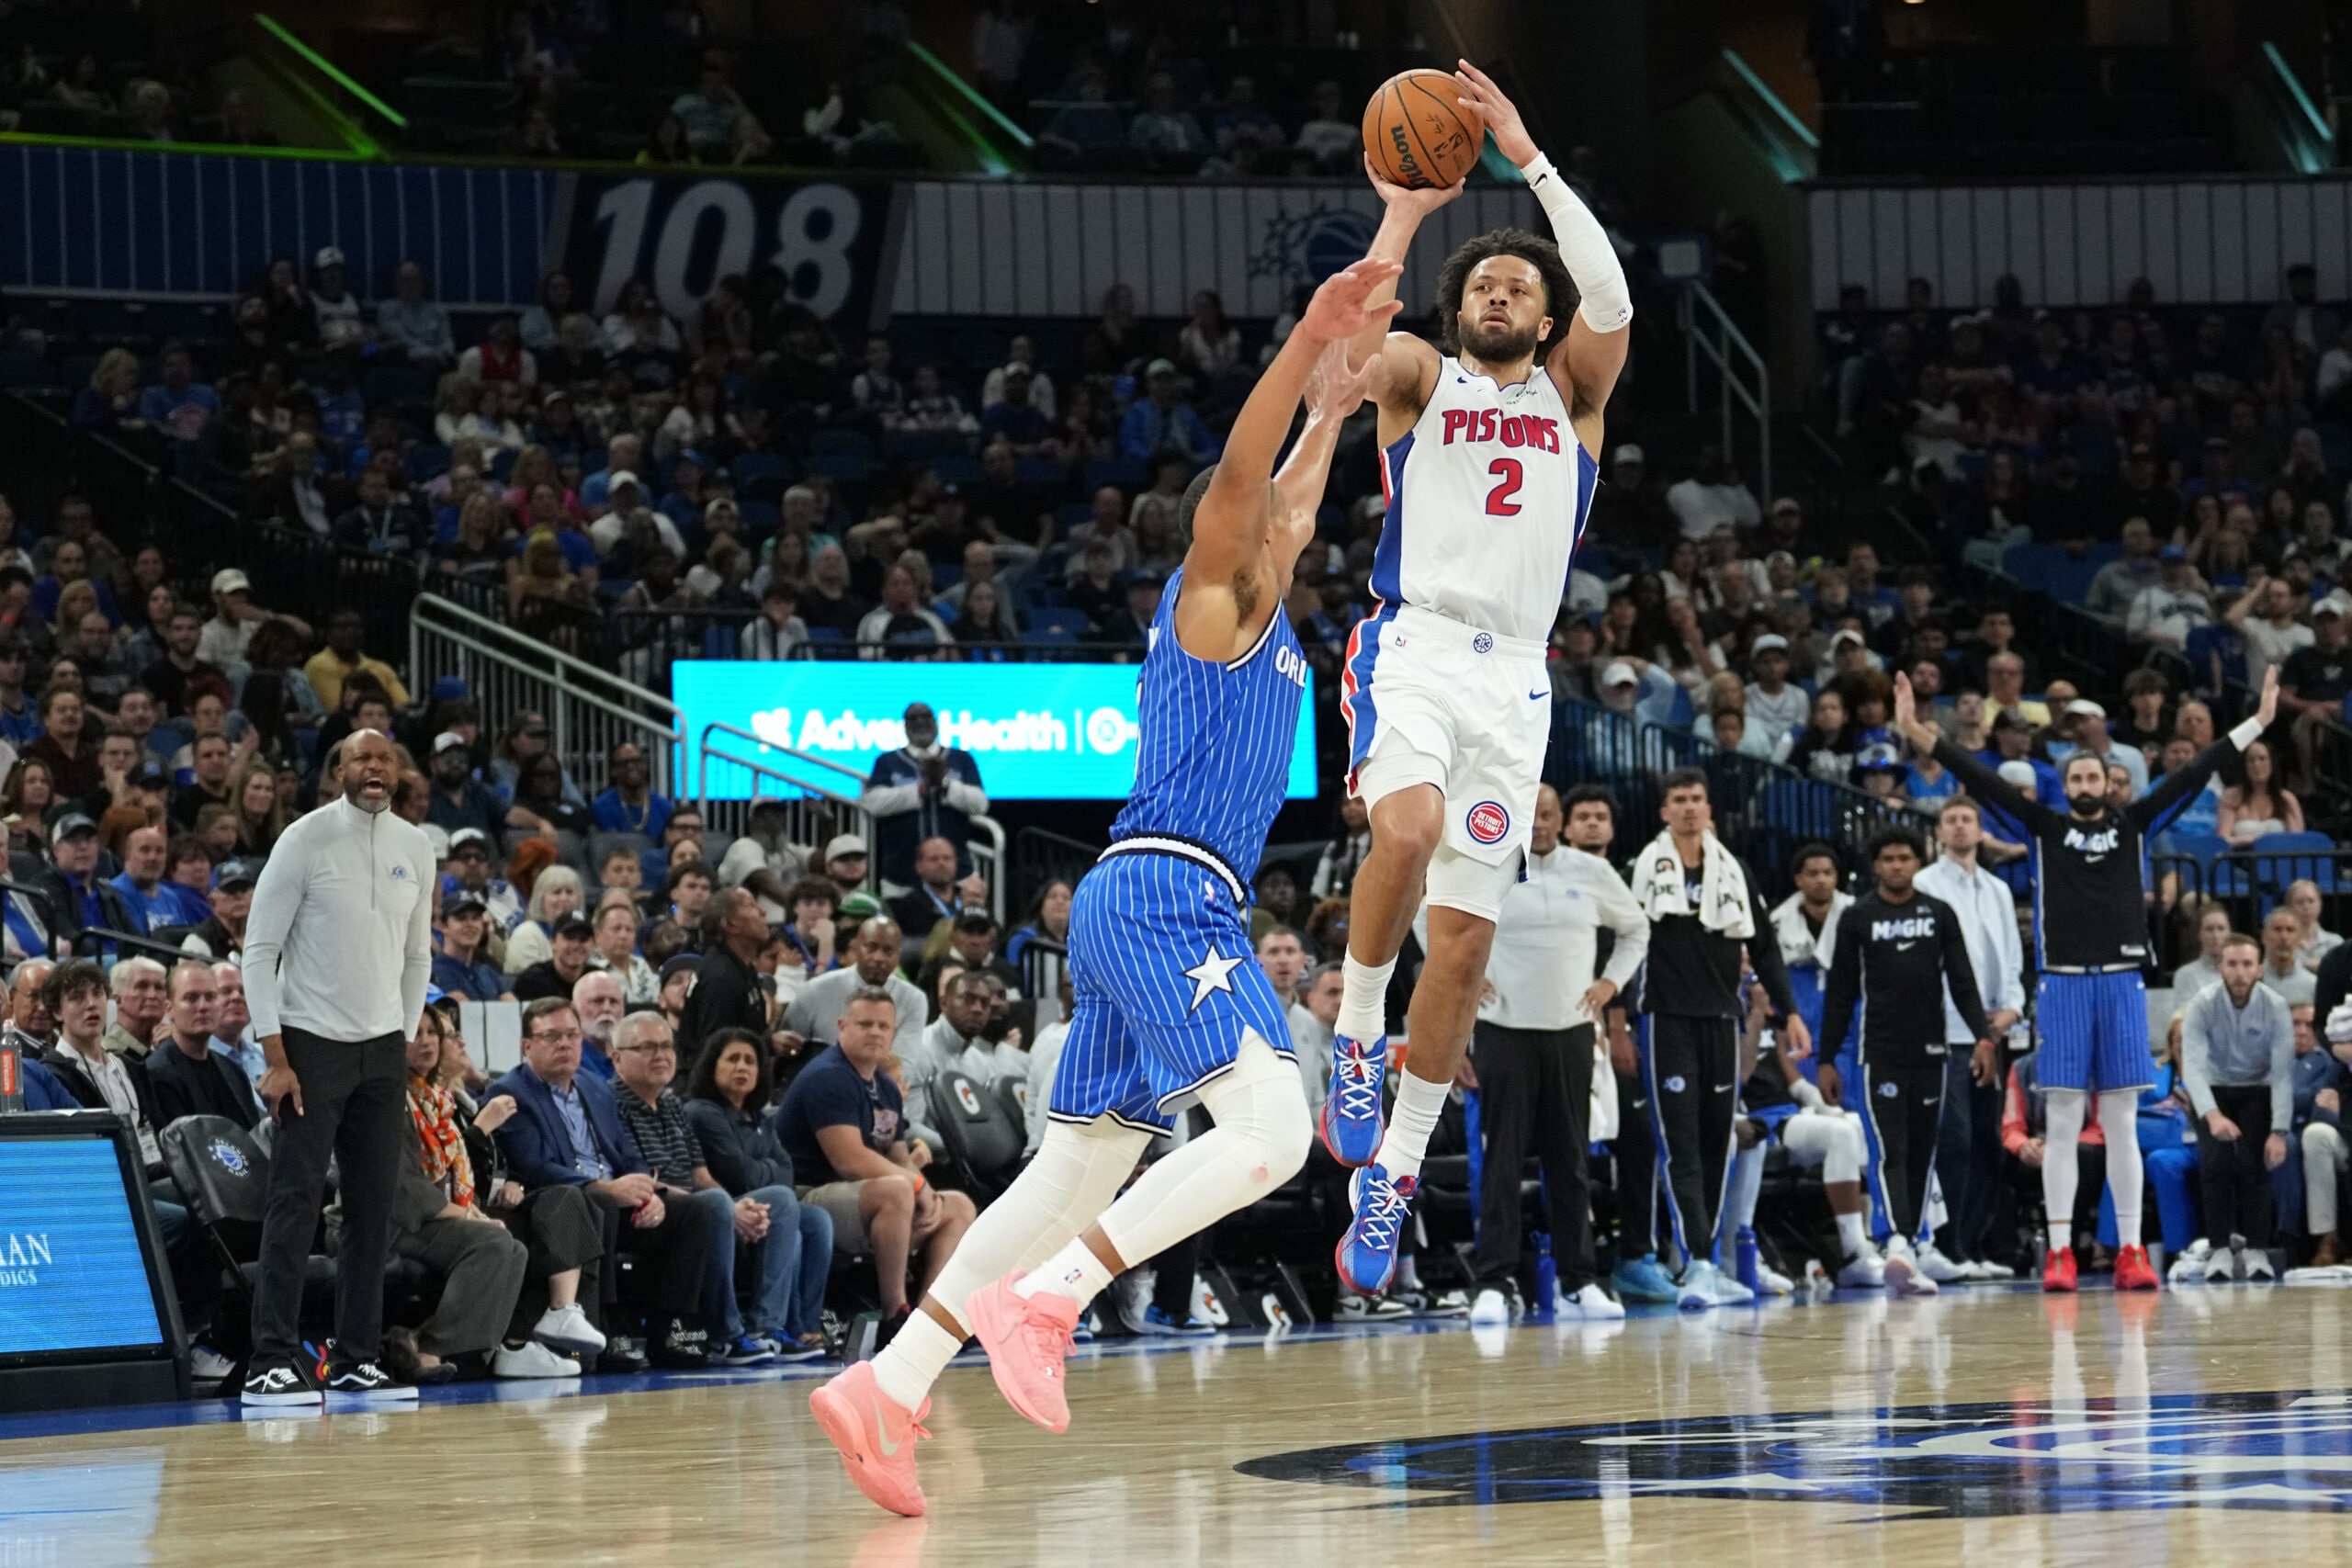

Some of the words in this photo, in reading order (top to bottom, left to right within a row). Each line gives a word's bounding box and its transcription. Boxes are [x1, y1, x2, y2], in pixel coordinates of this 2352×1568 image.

[592, 178, 862, 325] 108
[1486, 457, 1523, 516] 2
[1275, 646, 1306, 687] ORL
[1474, 817, 1499, 835] PISTONS
[1477, 810, 1503, 829] DETROIT
[2064, 828, 2119, 852] MAGIC
[1871, 918, 1935, 942] MAGIC
